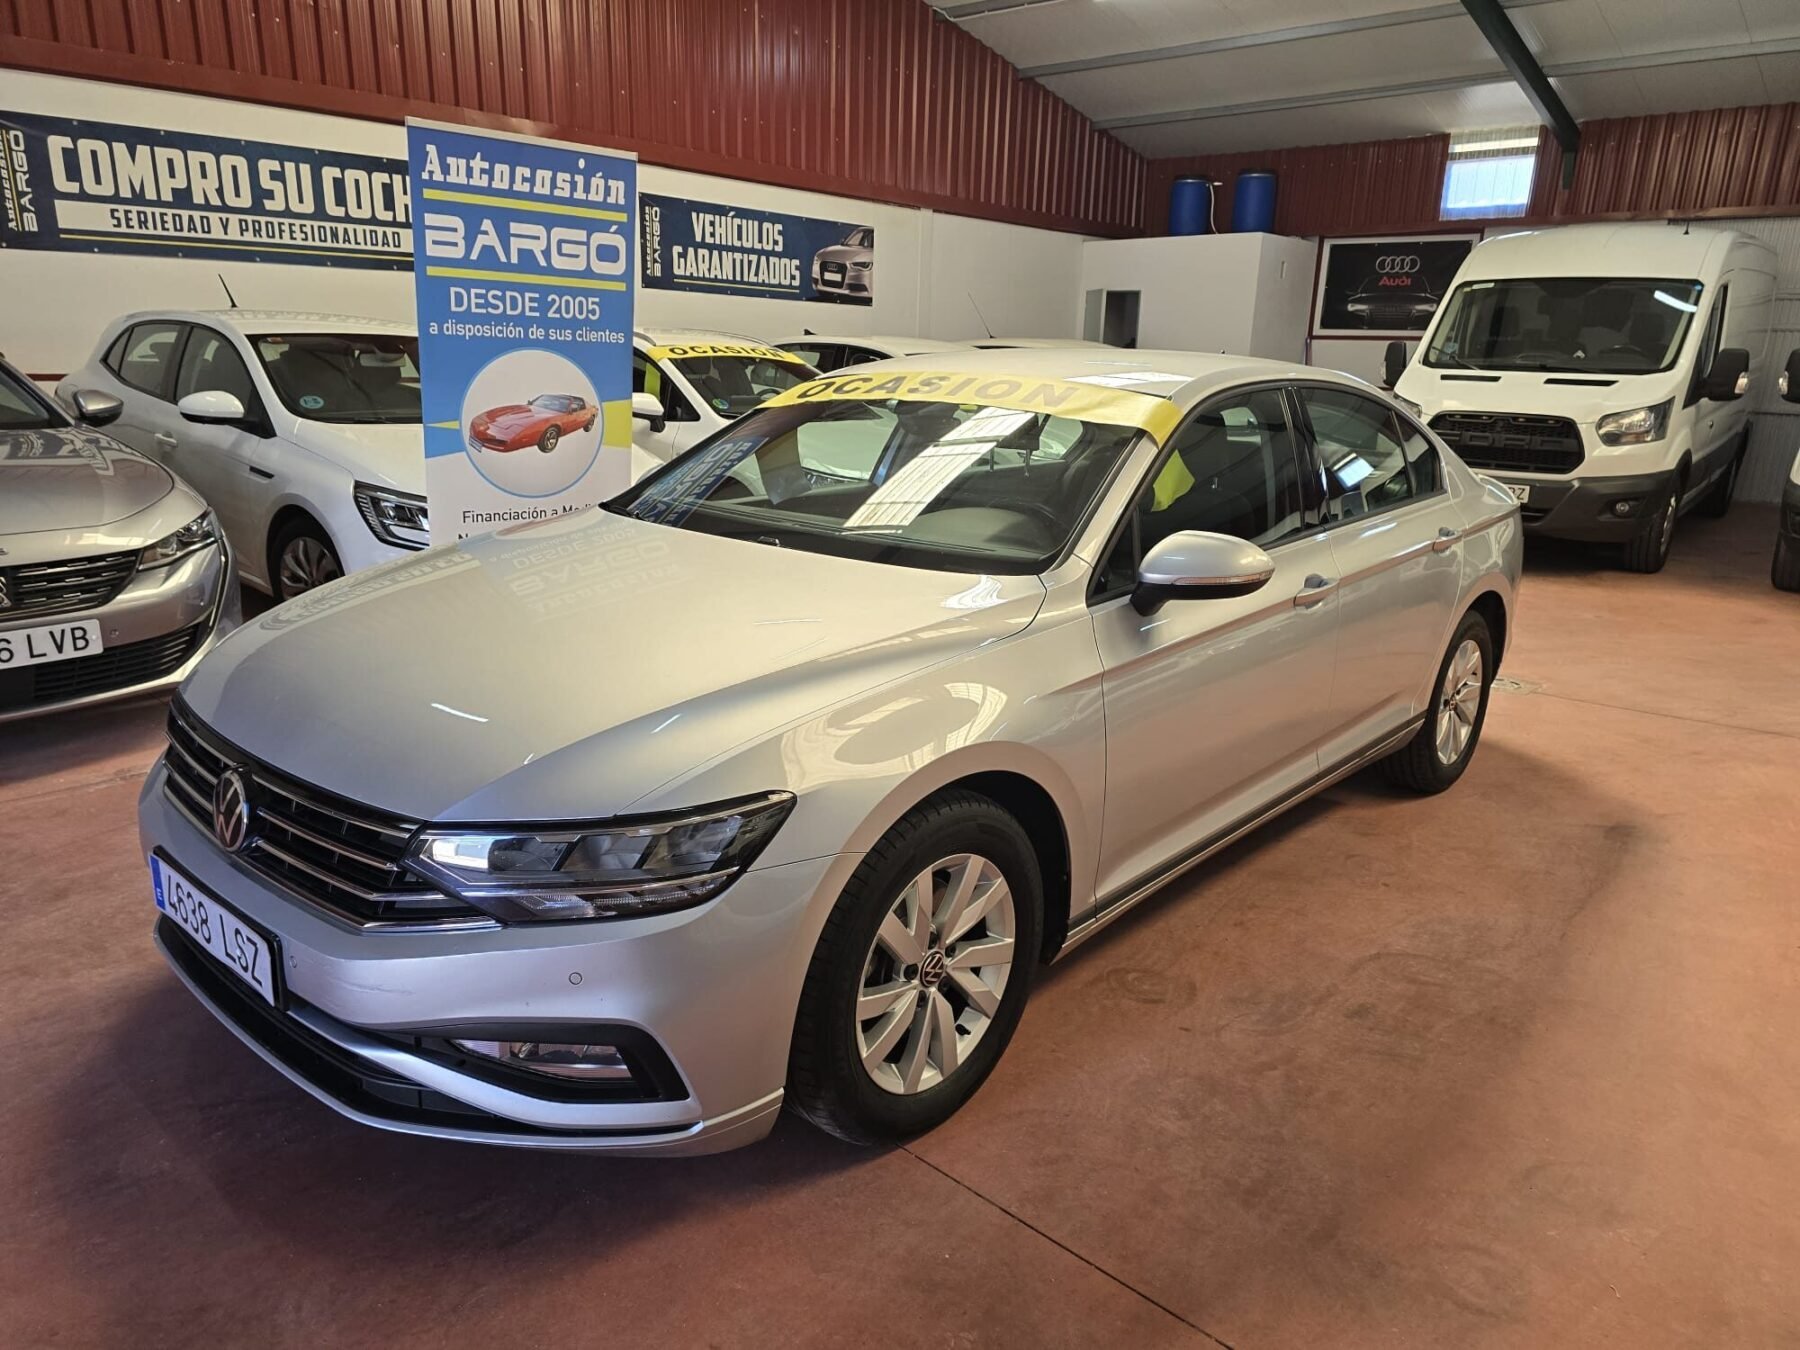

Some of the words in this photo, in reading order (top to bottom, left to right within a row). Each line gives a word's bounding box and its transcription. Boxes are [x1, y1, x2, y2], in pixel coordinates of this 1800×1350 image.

[47, 135, 252, 208] COMPRO
[258, 159, 315, 214] SU
[422, 144, 626, 205] Autocasión
[110, 209, 211, 235] SERIEDAD
[219, 217, 231, 237] Y
[239, 218, 401, 249] PROFESIONALIDAD
[424, 213, 626, 276] BARGÓ
[691, 212, 783, 252] VEHÍCULOS
[672, 246, 800, 287] GARANTIZADOS
[450, 286, 540, 317] DESDE
[547, 294, 600, 320] 2005
[429, 322, 438, 334] a
[443, 319, 524, 340] disposición
[529, 325, 545, 340] de
[549, 327, 572, 341] sus
[576, 327, 625, 344] clientes
[668, 345, 785, 360] OCASION
[796, 375, 1080, 408] OCASION
[463, 506, 547, 523] Financiación
[26, 626, 89, 659] LVB
[168, 874, 212, 945] 4638
[219, 913, 263, 988] LSZ
